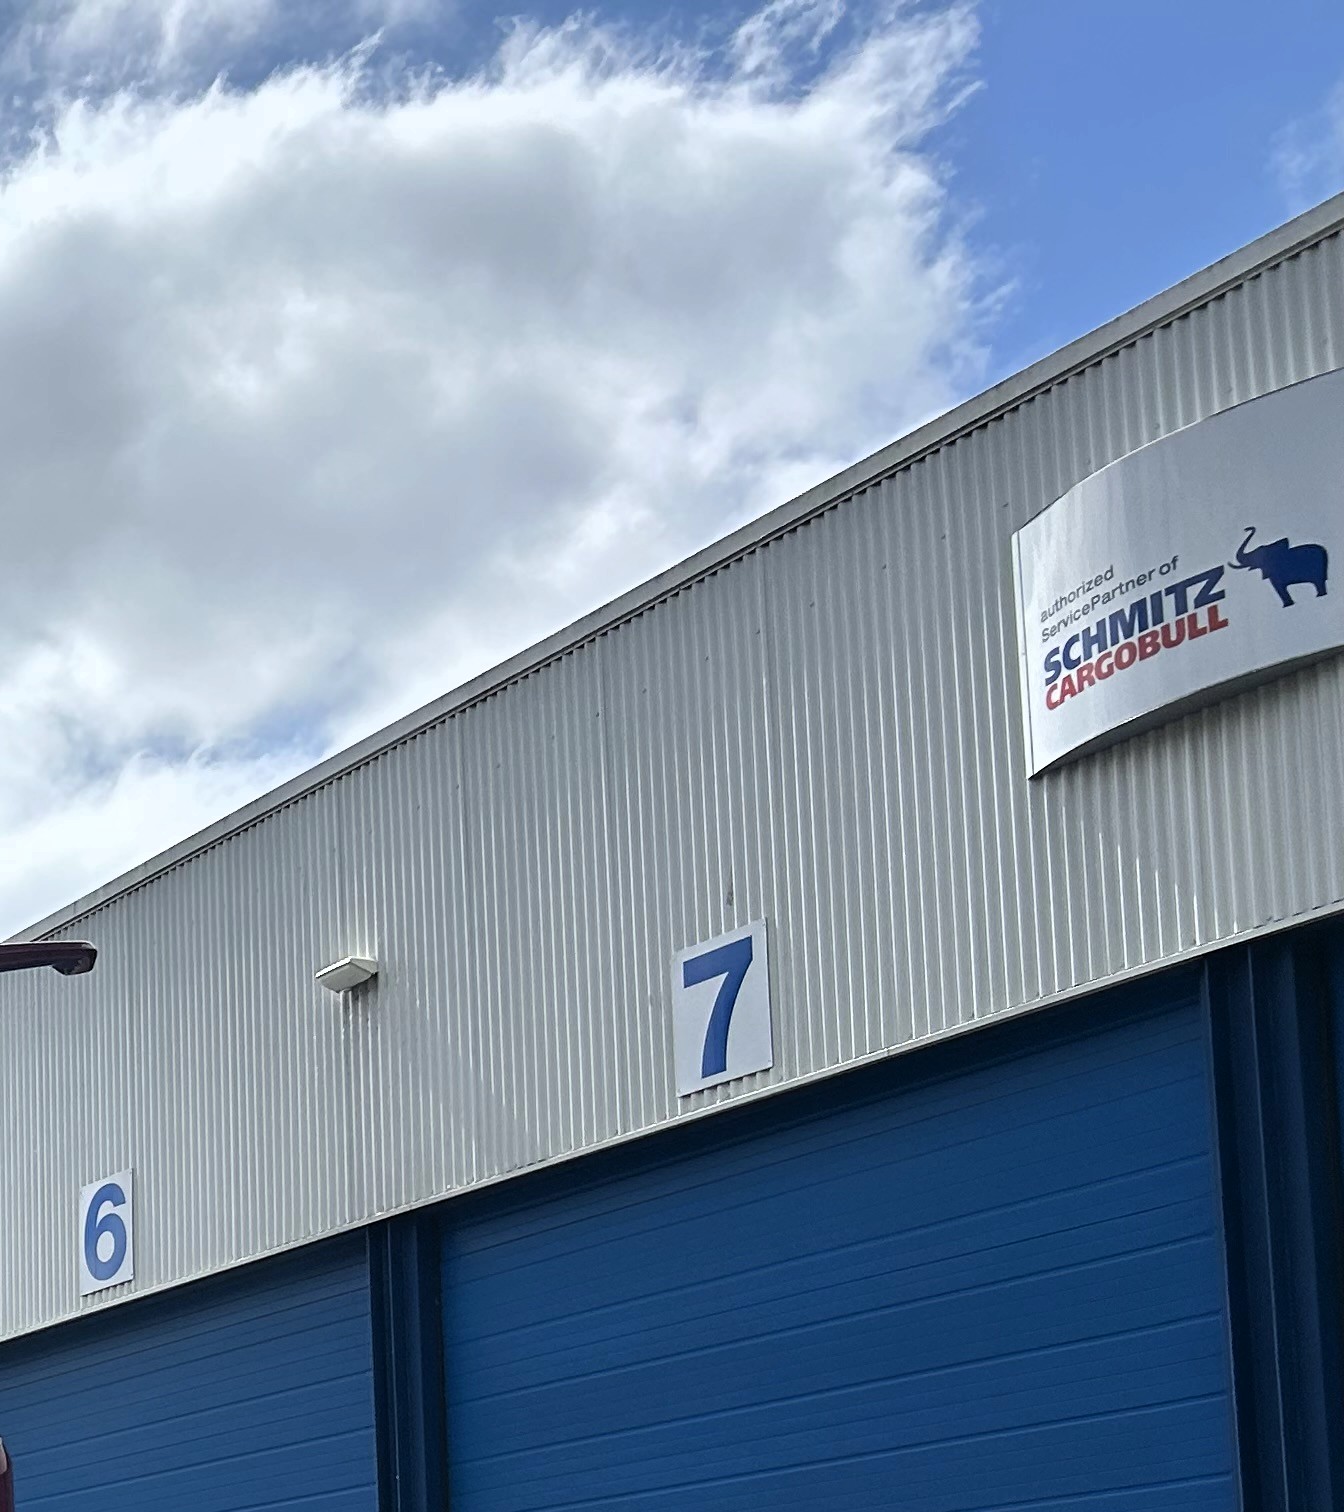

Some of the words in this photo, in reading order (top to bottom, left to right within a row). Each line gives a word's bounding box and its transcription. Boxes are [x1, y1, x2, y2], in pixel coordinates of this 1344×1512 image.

[1040, 564, 1114, 623] authorized
[1042, 568, 1156, 643] ServicePartner
[1158, 555, 1180, 577] of
[1044, 565, 1226, 687] SCHMITZ
[1045, 605, 1229, 711] CARGOBULL
[683, 936, 754, 1079] 7
[83, 1182, 127, 1281] 6
